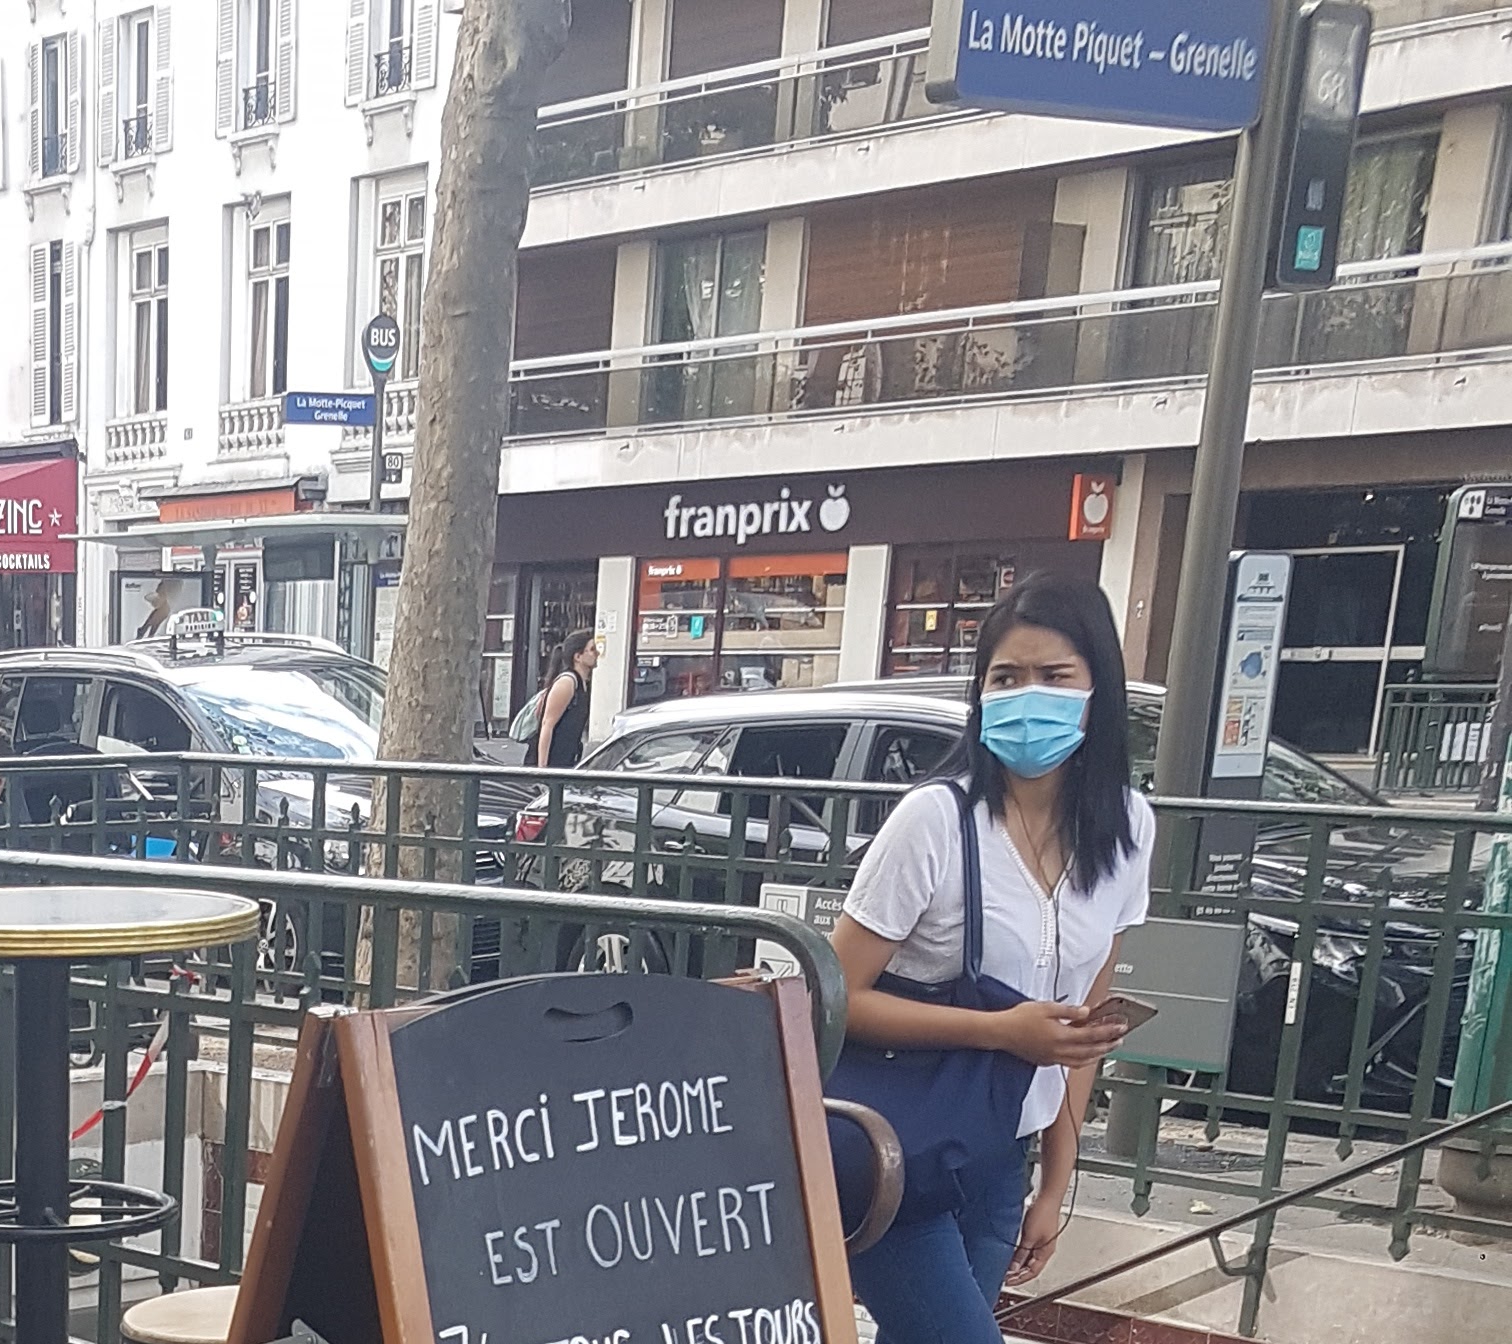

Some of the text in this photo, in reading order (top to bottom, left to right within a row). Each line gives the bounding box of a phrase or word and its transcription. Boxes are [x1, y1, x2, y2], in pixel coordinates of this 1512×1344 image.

[968, 9, 994, 51] La
[1000, 12, 1067, 60] Motte
[1072, 20, 1145, 75] Piquet
[1169, 30, 1259, 81] Grenelle
[370, 327, 396, 347] BUS
[387, 456, 400, 468] 80
[663, 487, 813, 545] franprix
[188, 611, 210, 624] TAXI
[814, 896, 843, 912] Accès
[813, 914, 831, 926] aux
[572, 1075, 734, 1154] JEROME
[484, 1181, 776, 1286] EST OUVERT
